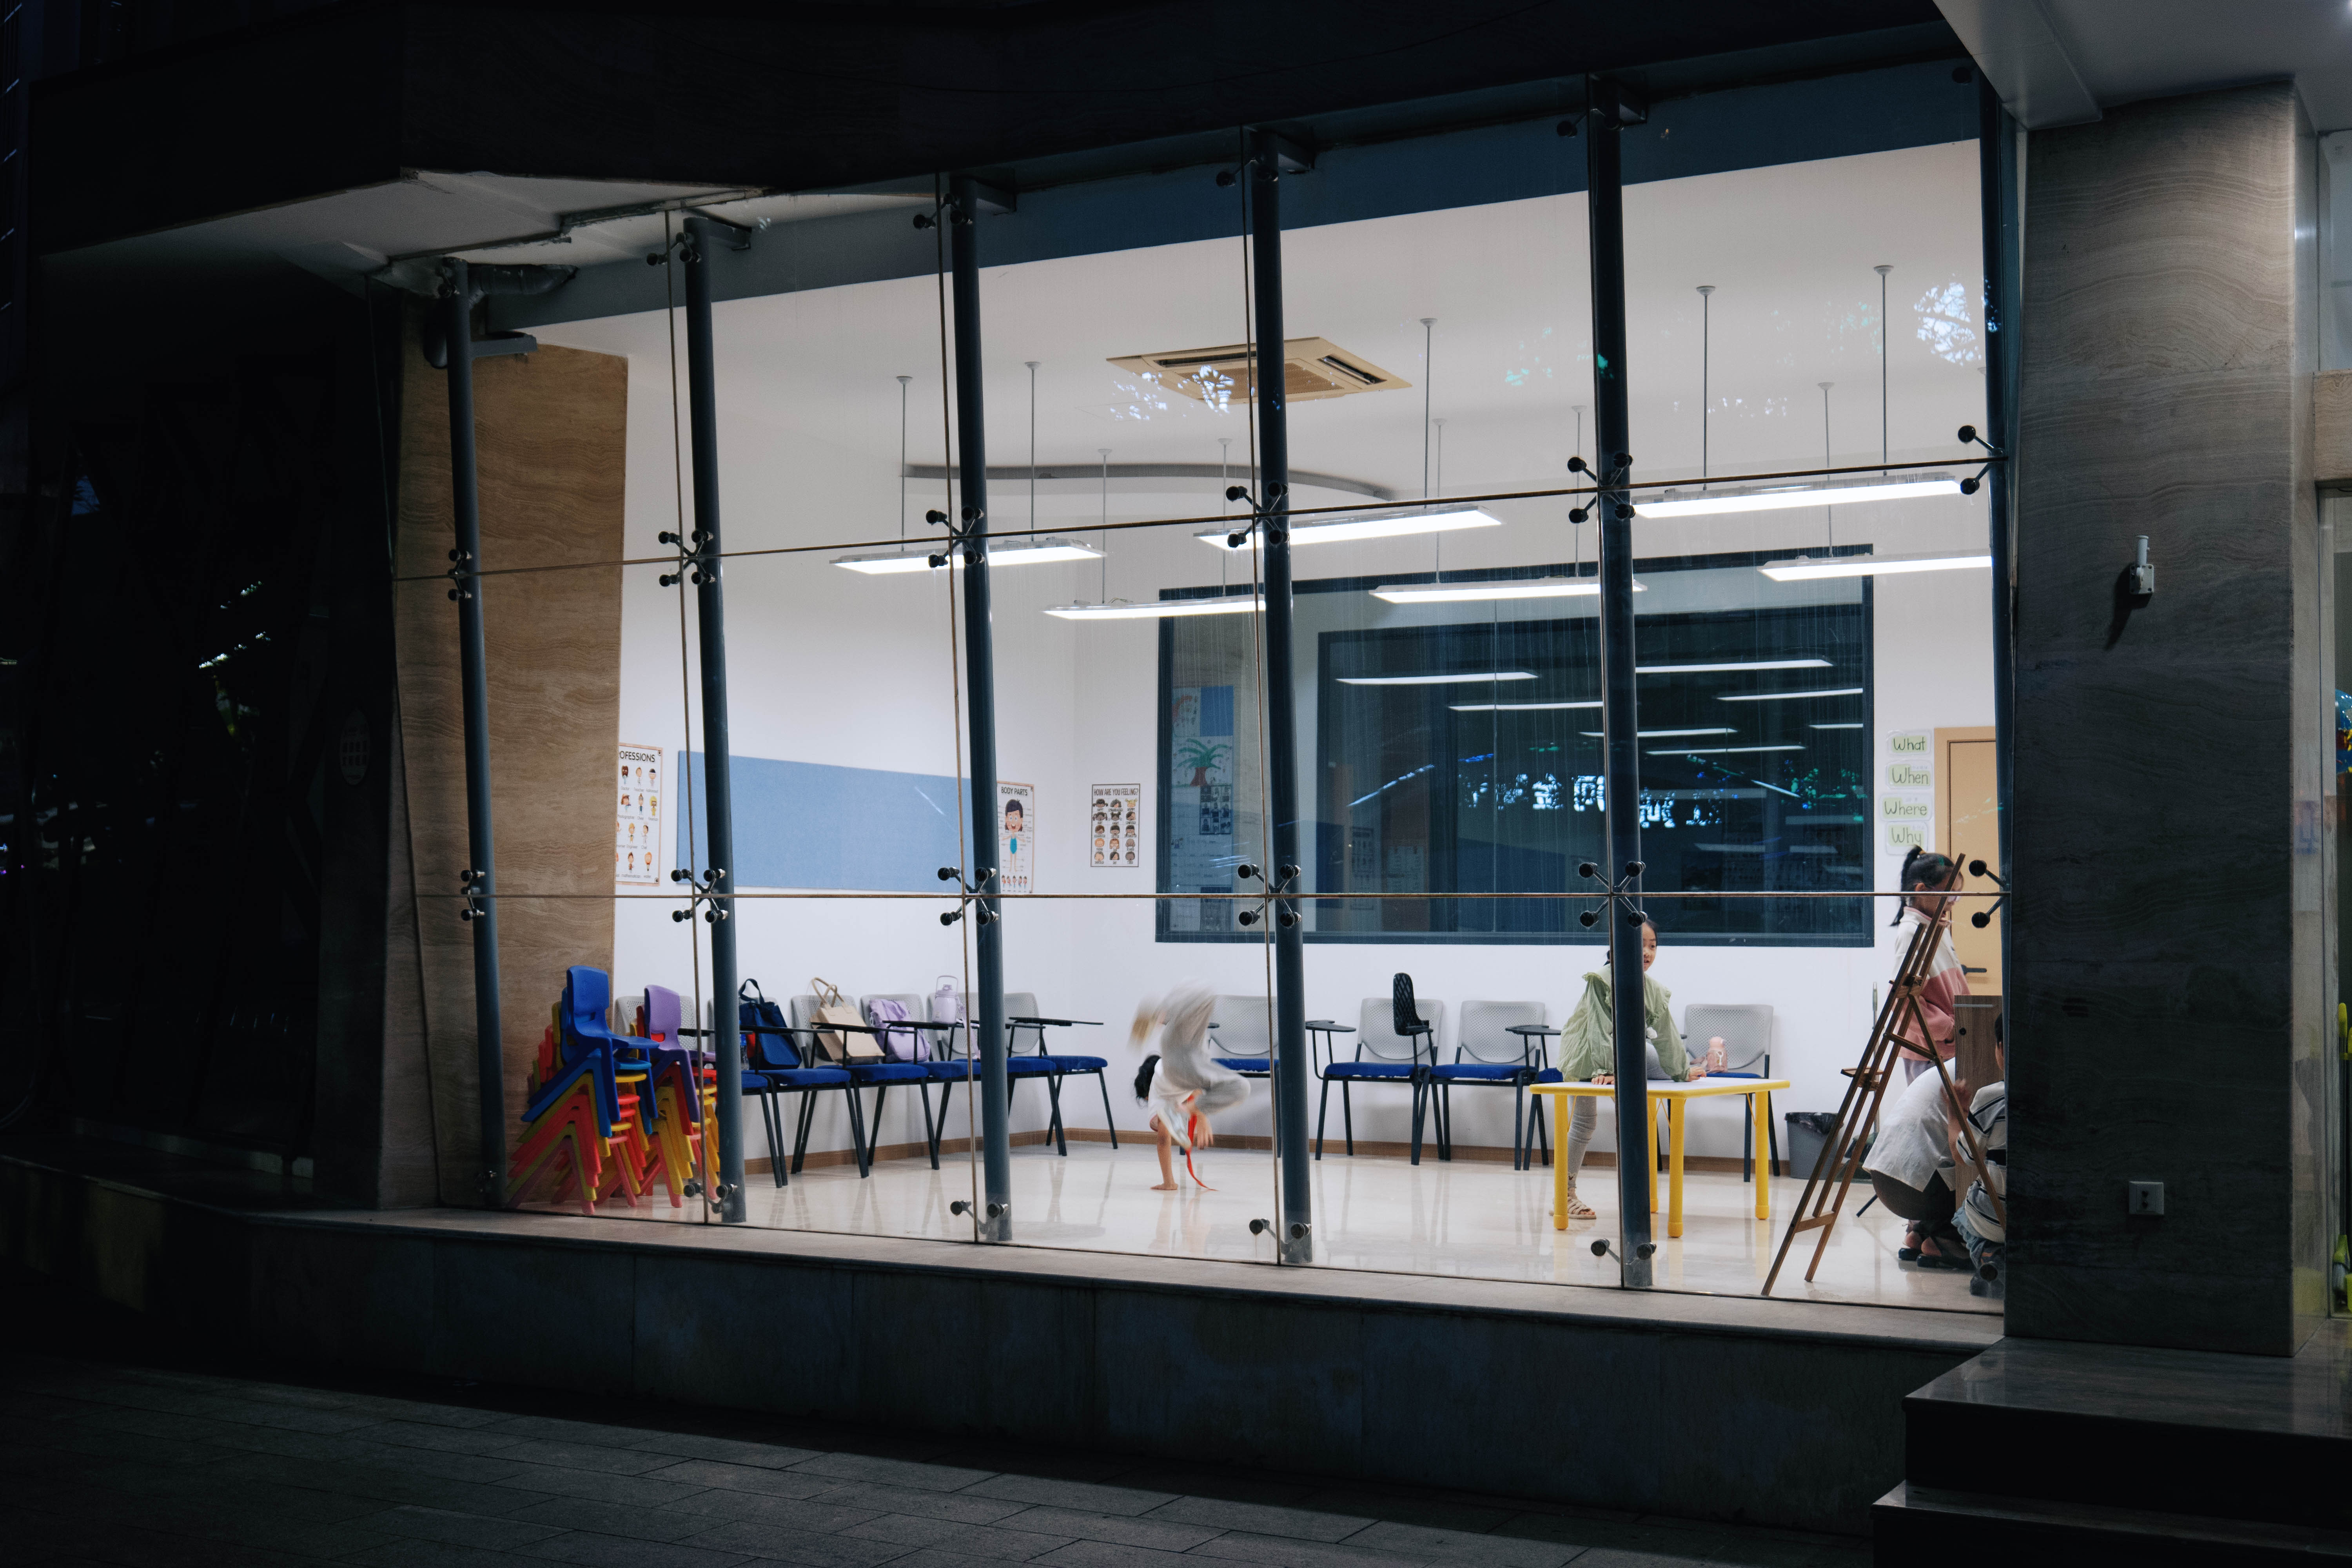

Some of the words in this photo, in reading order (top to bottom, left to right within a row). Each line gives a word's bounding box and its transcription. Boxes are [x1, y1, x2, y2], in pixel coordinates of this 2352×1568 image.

[1893, 737, 1926, 751] What
[619, 751, 655, 762] OFESSIONS
[1892, 767, 1929, 784] When
[1884, 800, 1927, 816] Where
[1891, 827, 1922, 845] Why
